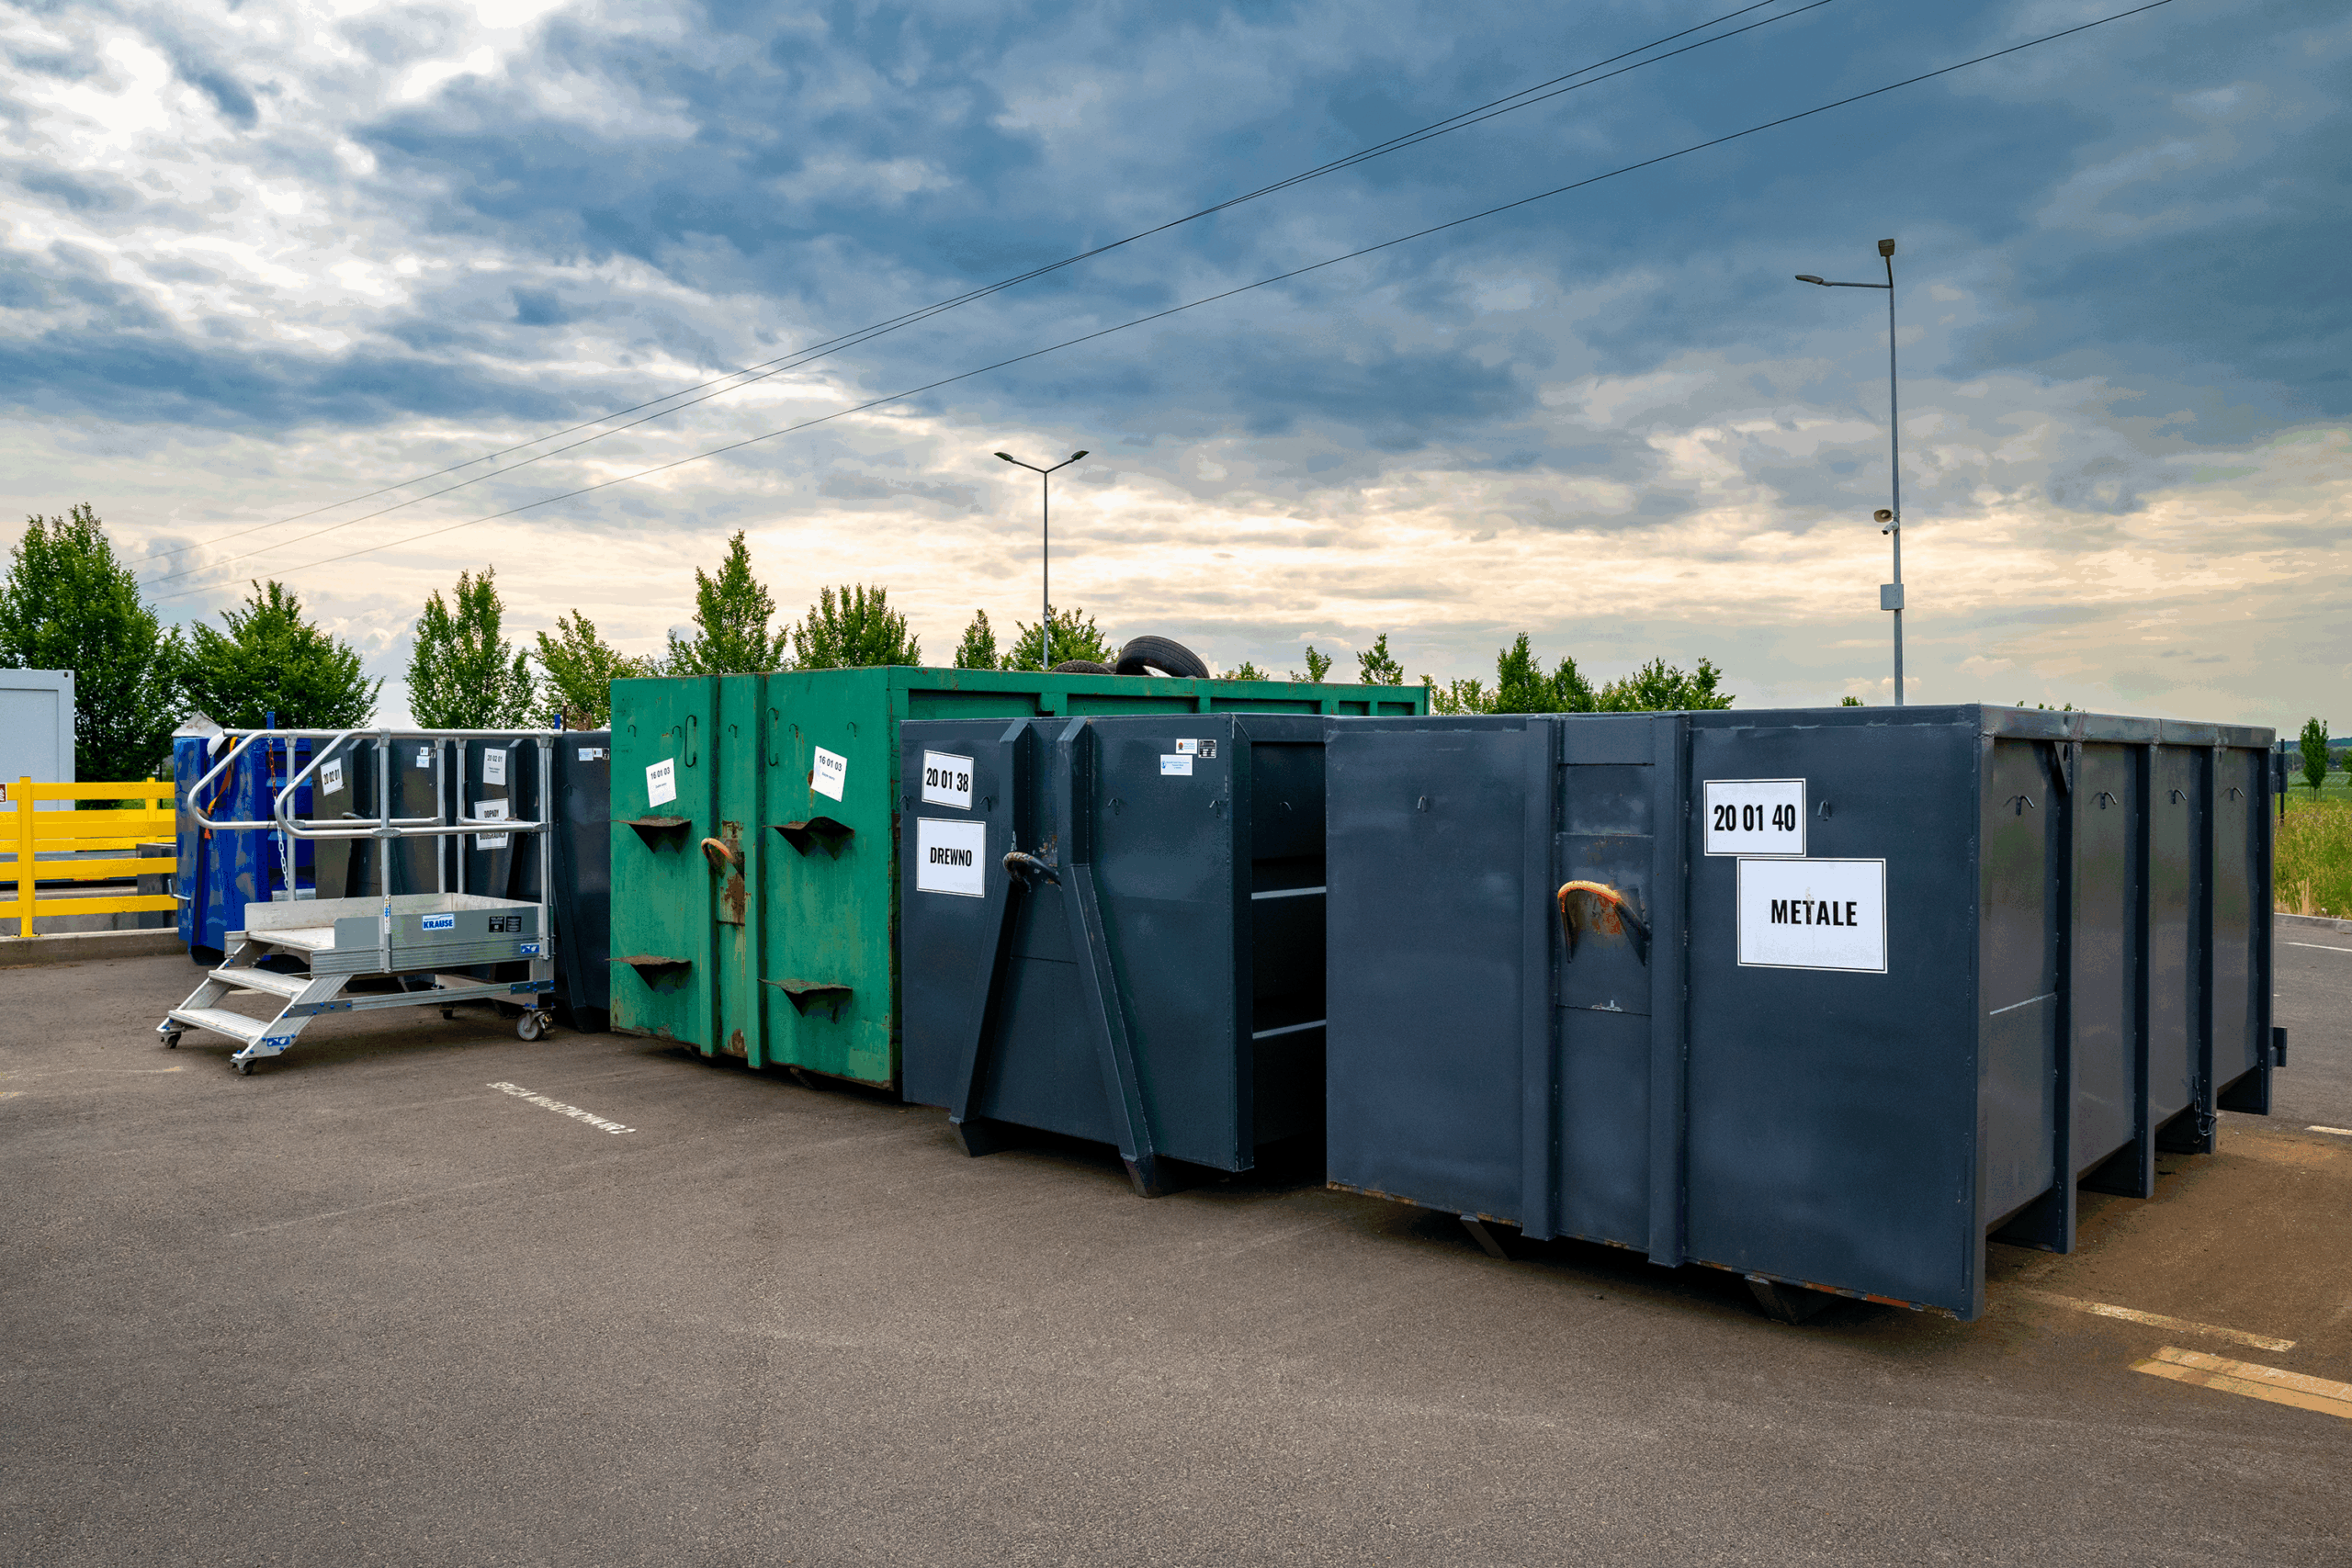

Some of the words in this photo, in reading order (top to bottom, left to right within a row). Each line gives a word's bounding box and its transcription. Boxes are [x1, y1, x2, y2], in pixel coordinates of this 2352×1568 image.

[650, 772, 656, 780] 16
[657, 769, 662, 778] 01
[663, 766, 671, 775] 03
[819, 755, 826, 765] 16
[827, 758, 833, 768] 01
[834, 761, 842, 772] 03
[926, 767, 939, 787] 20
[941, 769, 954, 790] 01
[956, 772, 969, 793] 38
[1713, 804, 1736, 831] 20
[1743, 804, 1763, 831] 01
[1772, 804, 1795, 831] 40
[930, 847, 972, 867] DREWNO
[1770, 899, 1858, 926] METALE
[424, 919, 453, 929] KRAUSE
